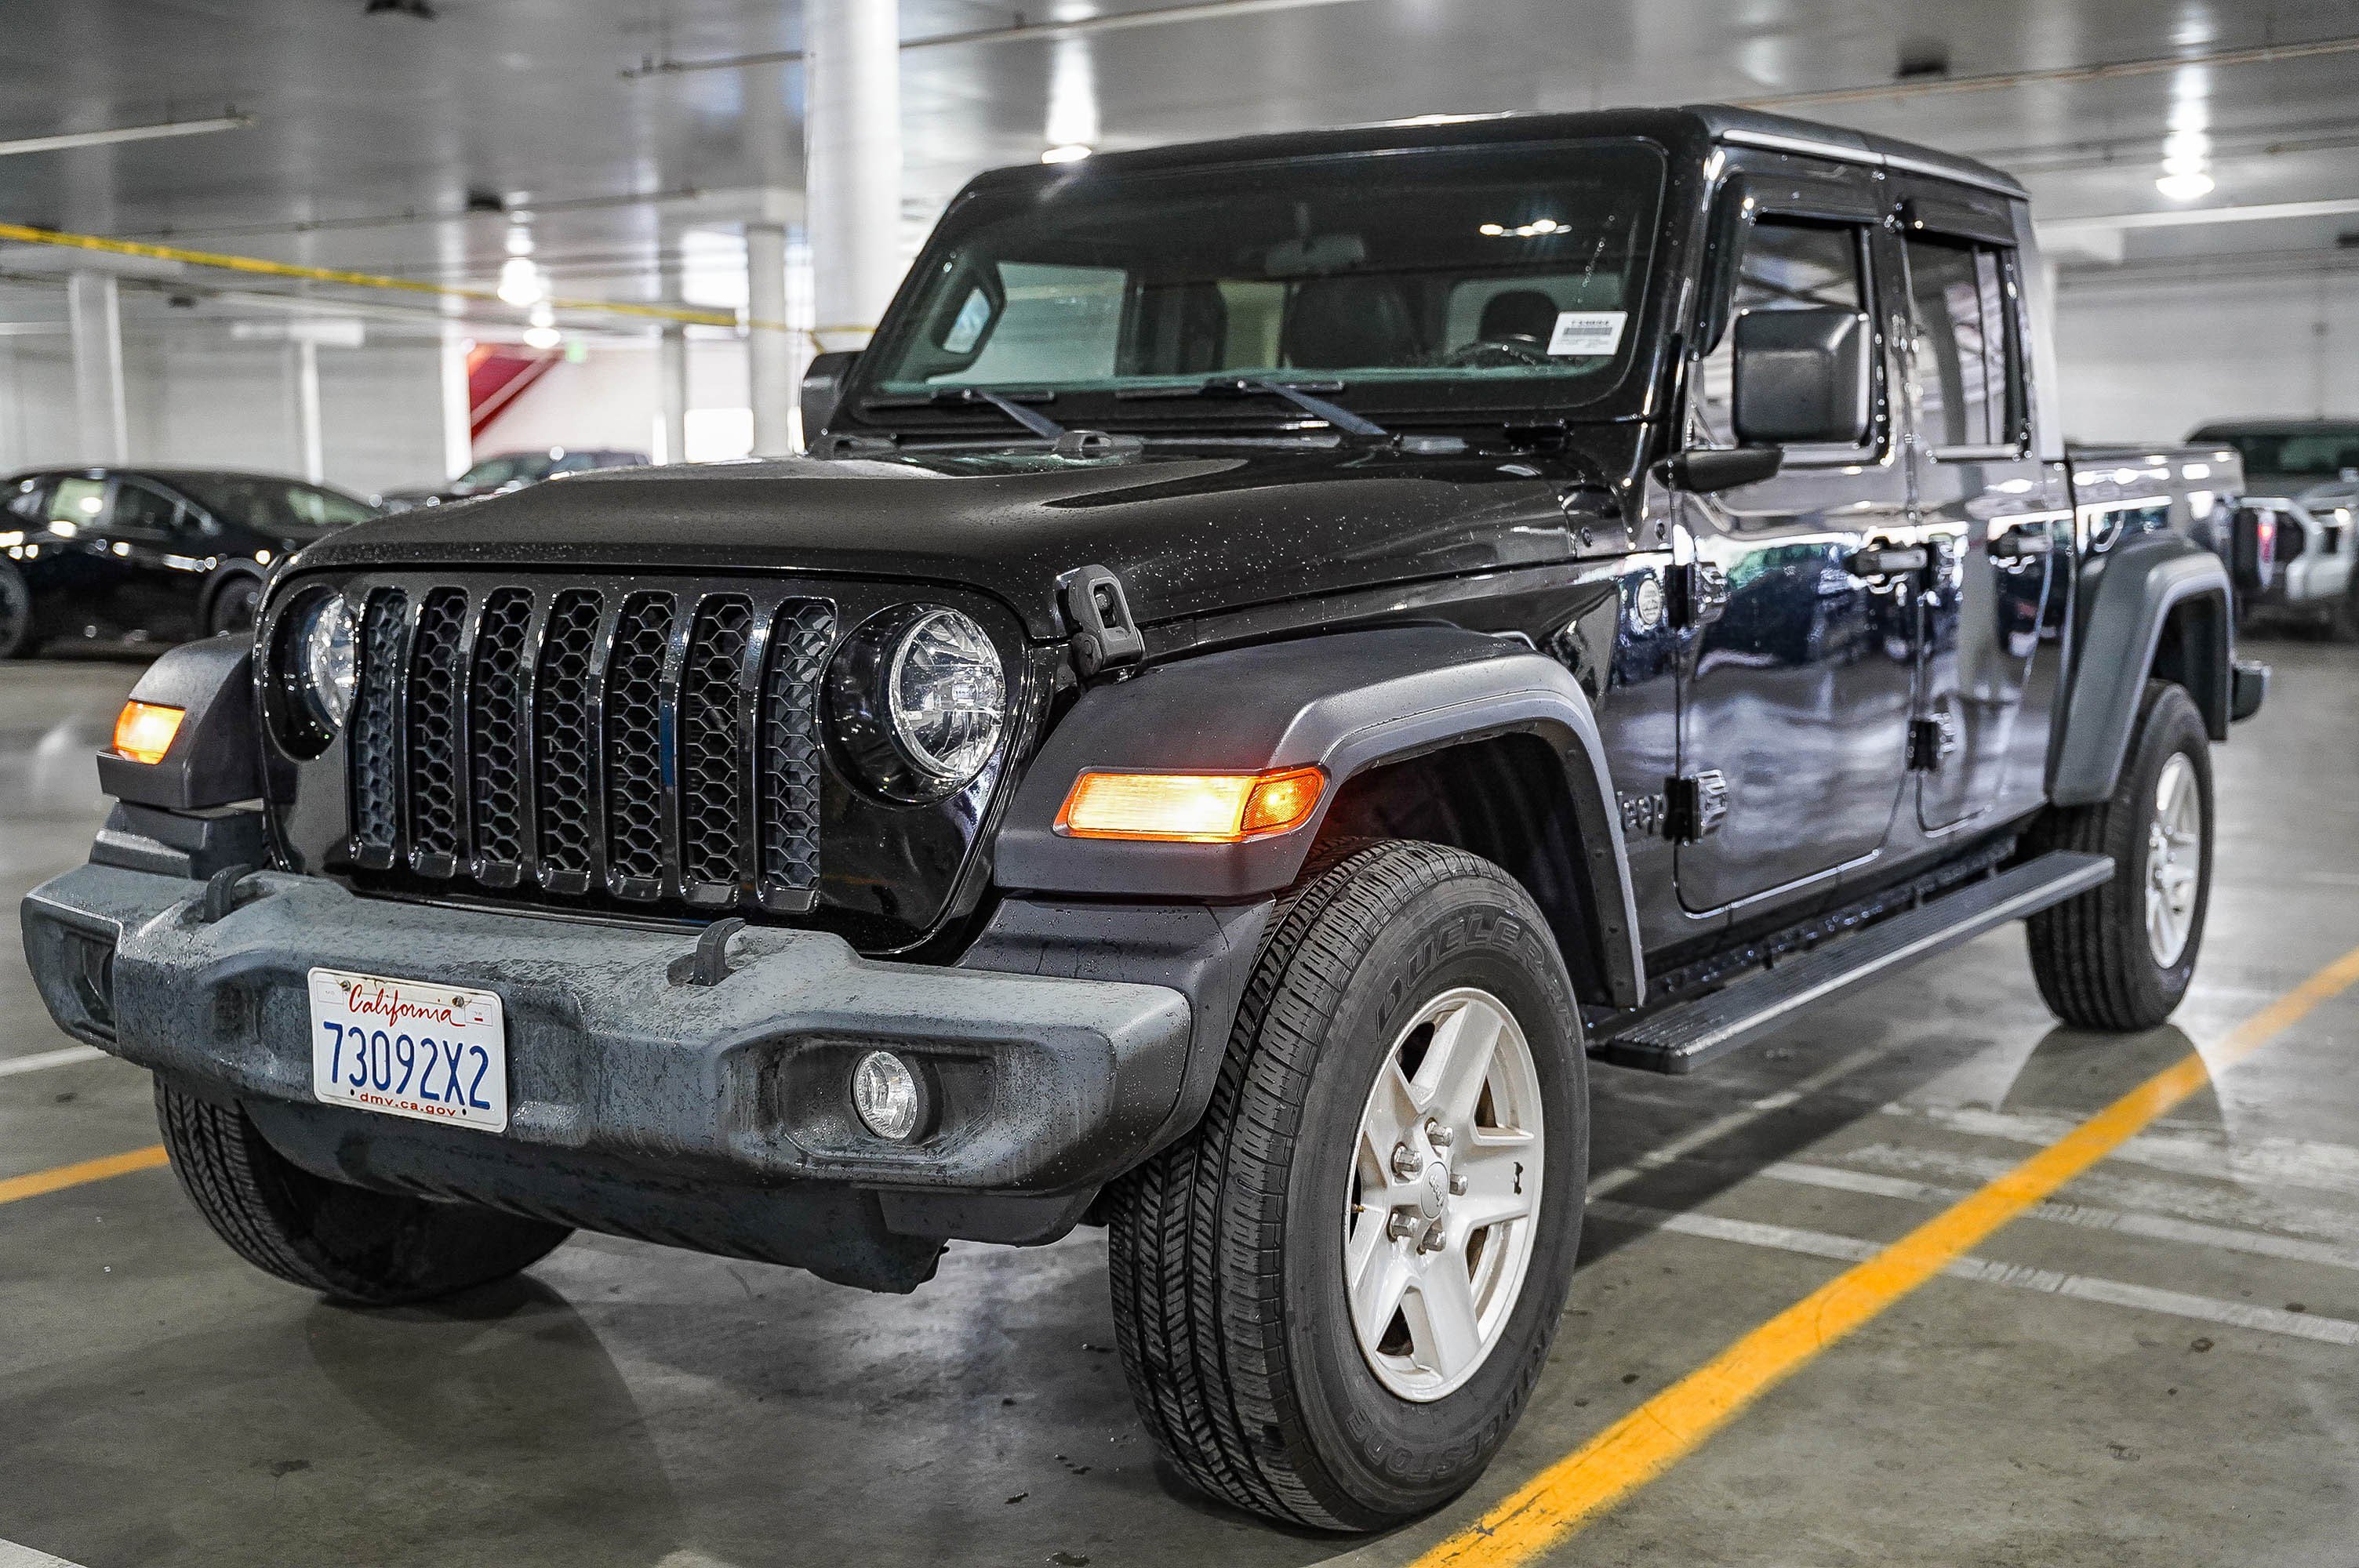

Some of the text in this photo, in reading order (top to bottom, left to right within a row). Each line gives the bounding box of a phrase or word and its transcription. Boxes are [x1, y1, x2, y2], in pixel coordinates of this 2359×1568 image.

[349, 984, 465, 1027] California
[1376, 913, 1545, 1040] DUELER
[323, 1022, 490, 1110] 73092X2
[359, 1092, 456, 1116] dmv.ca.gov
